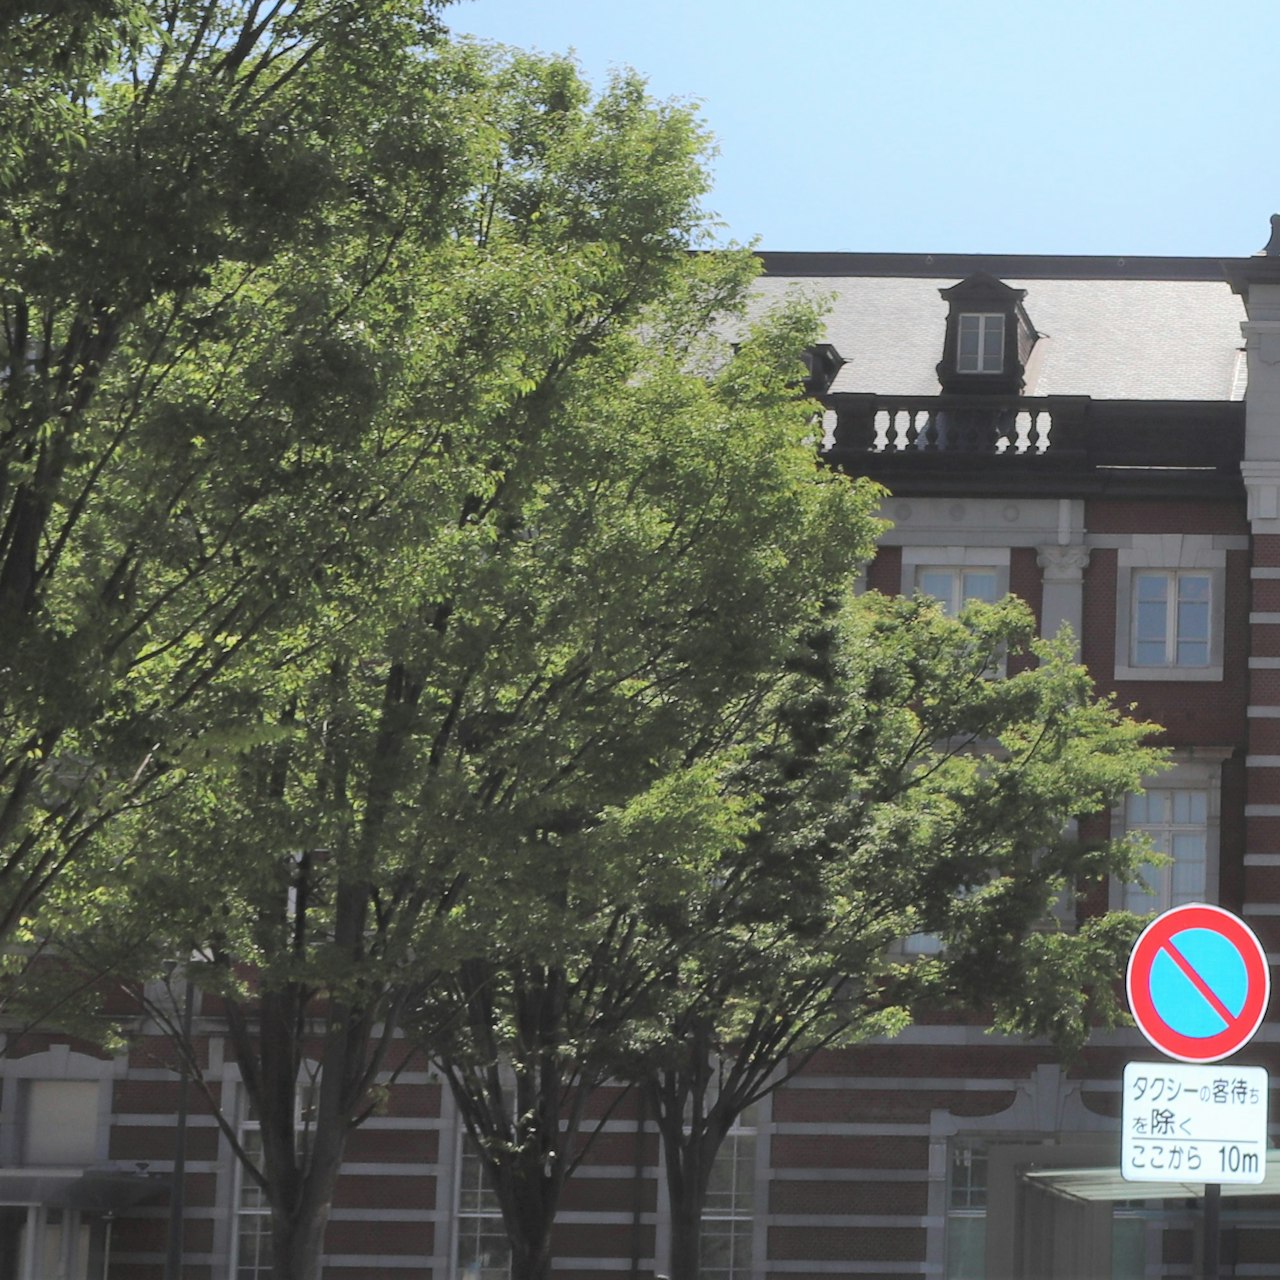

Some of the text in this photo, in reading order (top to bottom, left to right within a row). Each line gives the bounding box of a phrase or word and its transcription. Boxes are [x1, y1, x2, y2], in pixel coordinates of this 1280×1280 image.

[1133, 1076, 1260, 1105] タクシーの客待ち
[1132, 1108, 1192, 1135] を除く
[1131, 1145, 1259, 1173] ここから 10m
